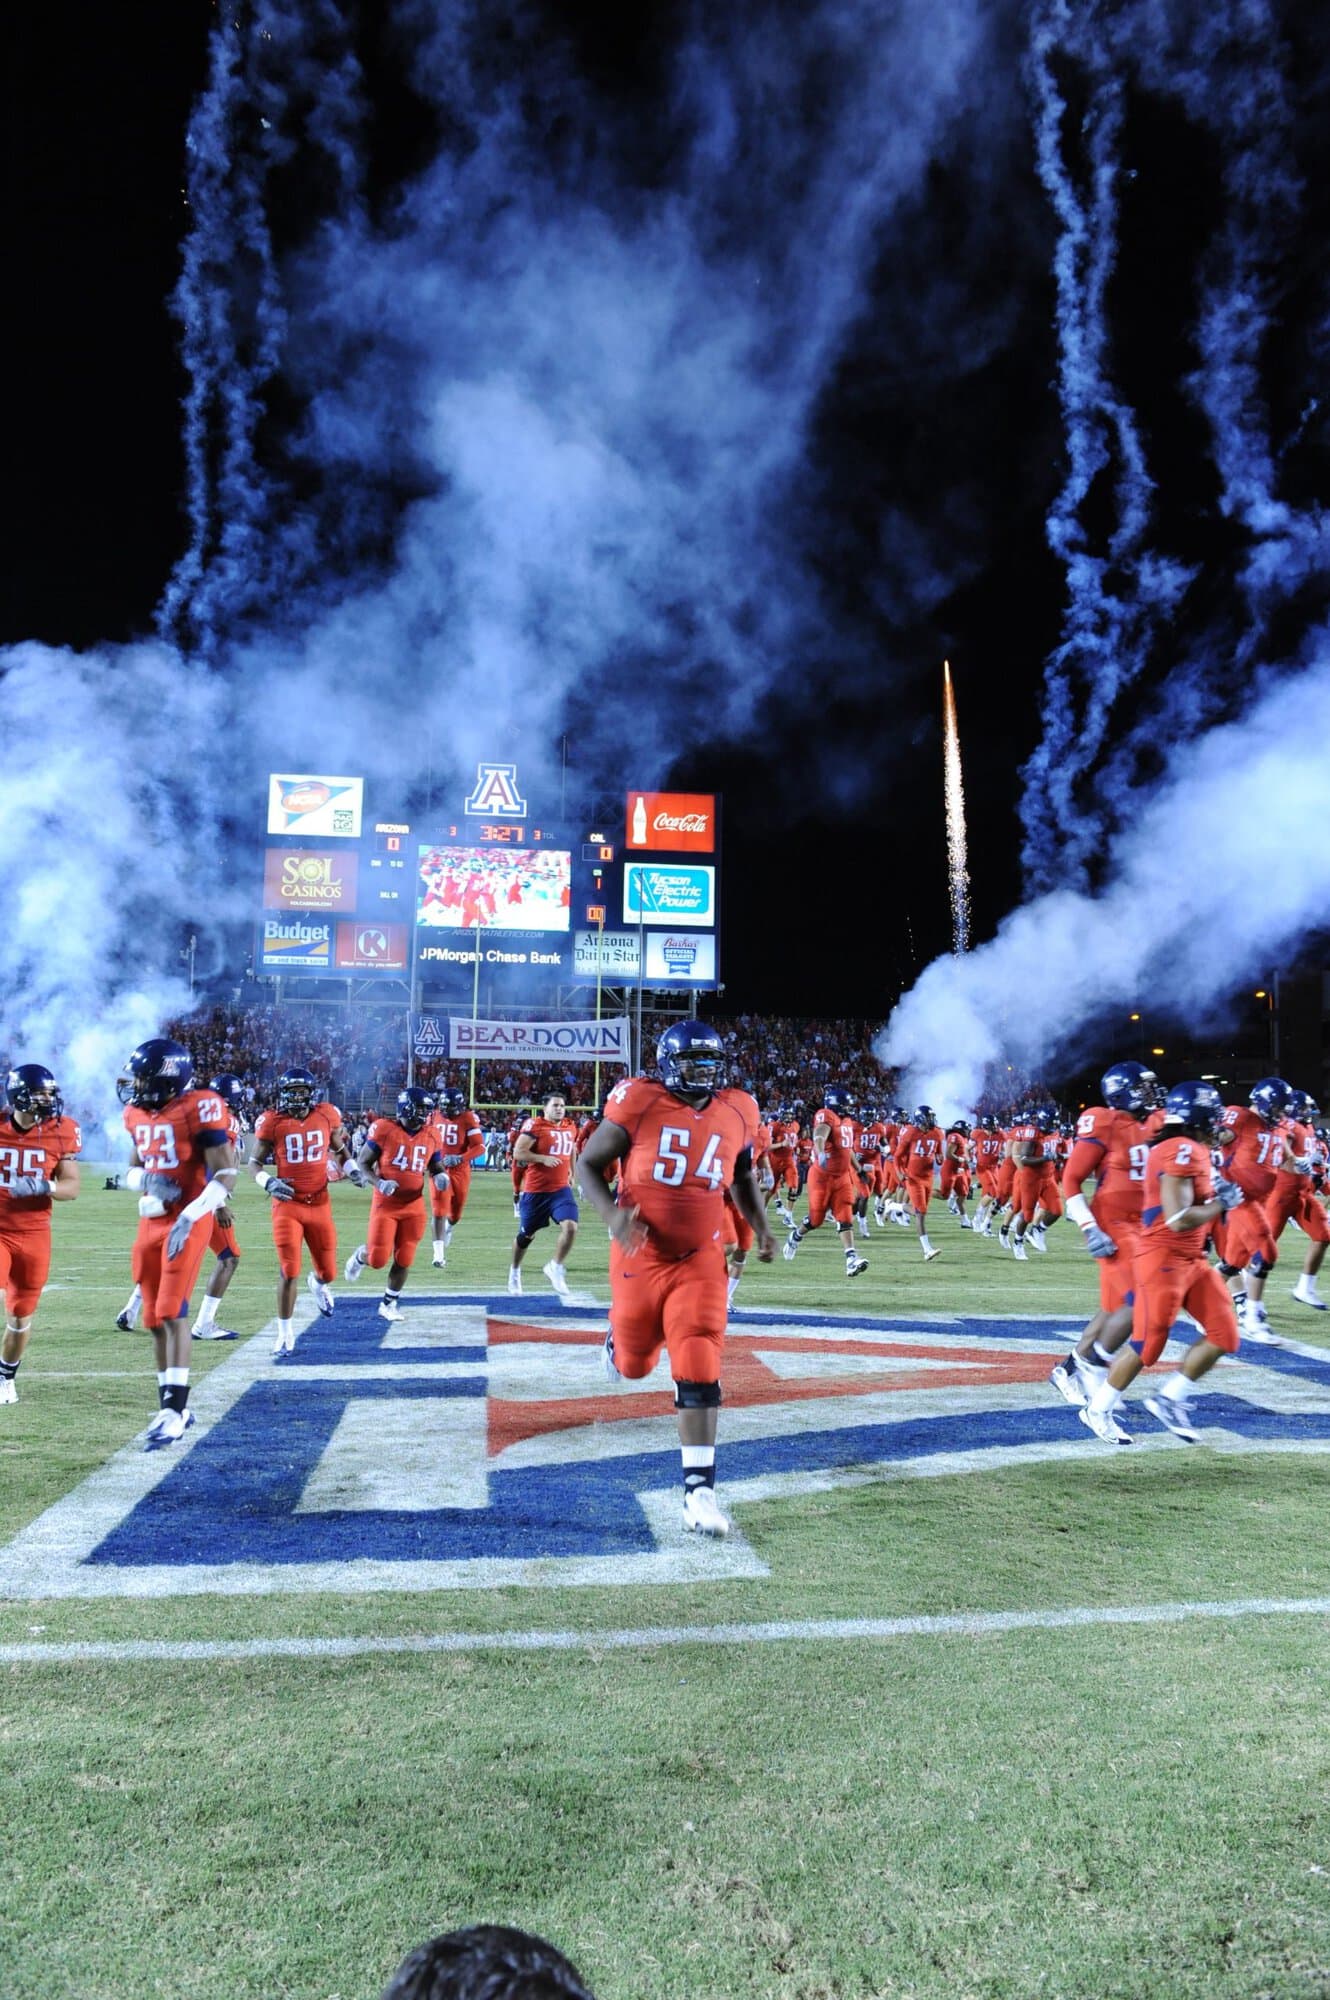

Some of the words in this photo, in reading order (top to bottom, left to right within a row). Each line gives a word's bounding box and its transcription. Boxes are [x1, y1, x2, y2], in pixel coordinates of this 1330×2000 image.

[479, 825, 524, 842] 3:27
[282, 857, 342, 886] SOL
[649, 872, 691, 886] Tucson
[281, 884, 342, 898] CASINOS
[653, 884, 702, 896] Electric
[658, 896, 702, 908] Power
[264, 920, 330, 944] Budget
[583, 933, 634, 948] Arzona
[360, 930, 386, 957] K
[420, 947, 483, 964] JPMorgan
[486, 950, 527, 963] Chase
[530, 952, 561, 965] Bank
[575, 948, 610, 964] Daiy
[613, 949, 641, 962] Star
[414, 1045, 445, 1056] CLUB
[197, 1097, 223, 1124] 23
[135, 1122, 180, 1171] 23
[284, 1129, 324, 1164] 82
[548, 1129, 573, 1156] 36
[914, 1138, 937, 1158] 47
[982, 1139, 999, 1155] 37
[1256, 1132, 1284, 1167] 72
[391, 1144, 428, 1172] 46
[652, 1125, 724, 1190] 54
[1174, 1143, 1193, 1166] 2
